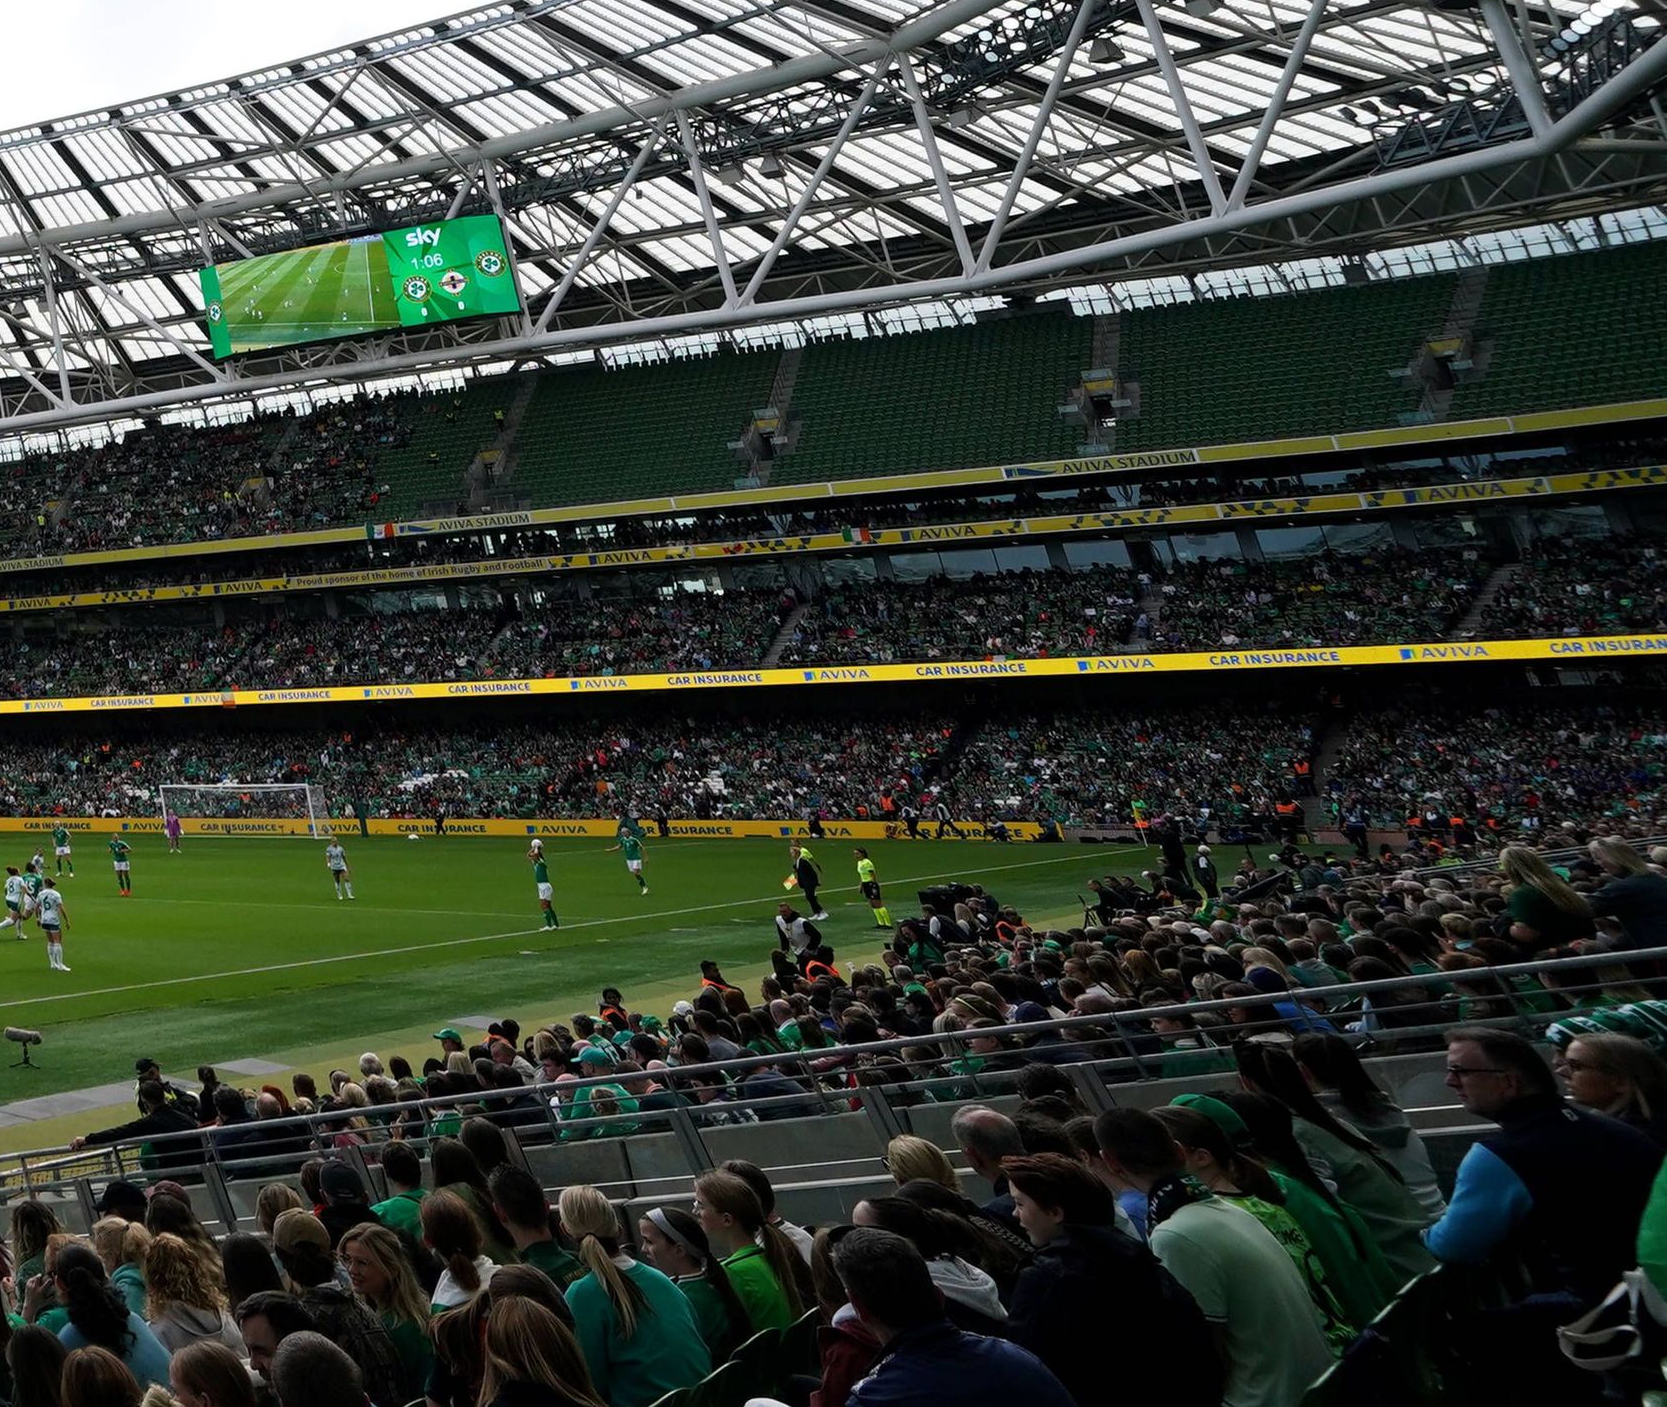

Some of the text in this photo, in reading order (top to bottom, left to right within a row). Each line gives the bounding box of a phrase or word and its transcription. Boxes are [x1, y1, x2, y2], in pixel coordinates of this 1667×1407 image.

[406, 227, 441, 247] sky
[411, 253, 443, 270] 1:06
[458, 301, 465, 310] 0
[421, 307, 428, 316] 0
[1062, 449, 1196, 474] AVIVA STADIUM
[1428, 483, 1507, 501] AVIVA
[438, 515, 530, 531] AVIVA STADIUM
[919, 526, 978, 539] AVIVA
[604, 551, 652, 564] AVIVA
[26, 558, 64, 569] STADIUM
[296, 559, 543, 587] Proud sponsor of the home of Irish Rugby and Football
[225, 582, 263, 593] AVIVA
[19, 599, 52, 608] AVIVA
[1421, 646, 1488, 659] AVIVA
[1549, 642, 1582, 654] CAR
[1097, 658, 1155, 669] AVIVA
[1209, 651, 1340, 666] CAR INSURANCE
[820, 669, 869, 680] AVIVA
[916, 663, 1027, 676] CAR INSURANCE
[584, 678, 628, 689] AVIVA
[667, 674, 763, 686] CAR INSURANCE
[376, 687, 414, 697] AVIVA
[448, 683, 531, 694] CAR INSURANCE
[258, 690, 331, 701] CAR INSURANCE
[33, 700, 64, 709] AVIVA
[90, 697, 155, 707] CAR INSURANCE
[24, 823, 40, 831] CAR
[200, 824, 277, 832] CAR INSURANCE
[398, 824, 423, 834] CAR
[542, 825, 588, 834] AVIVA
[43, 895, 52, 910] 6
